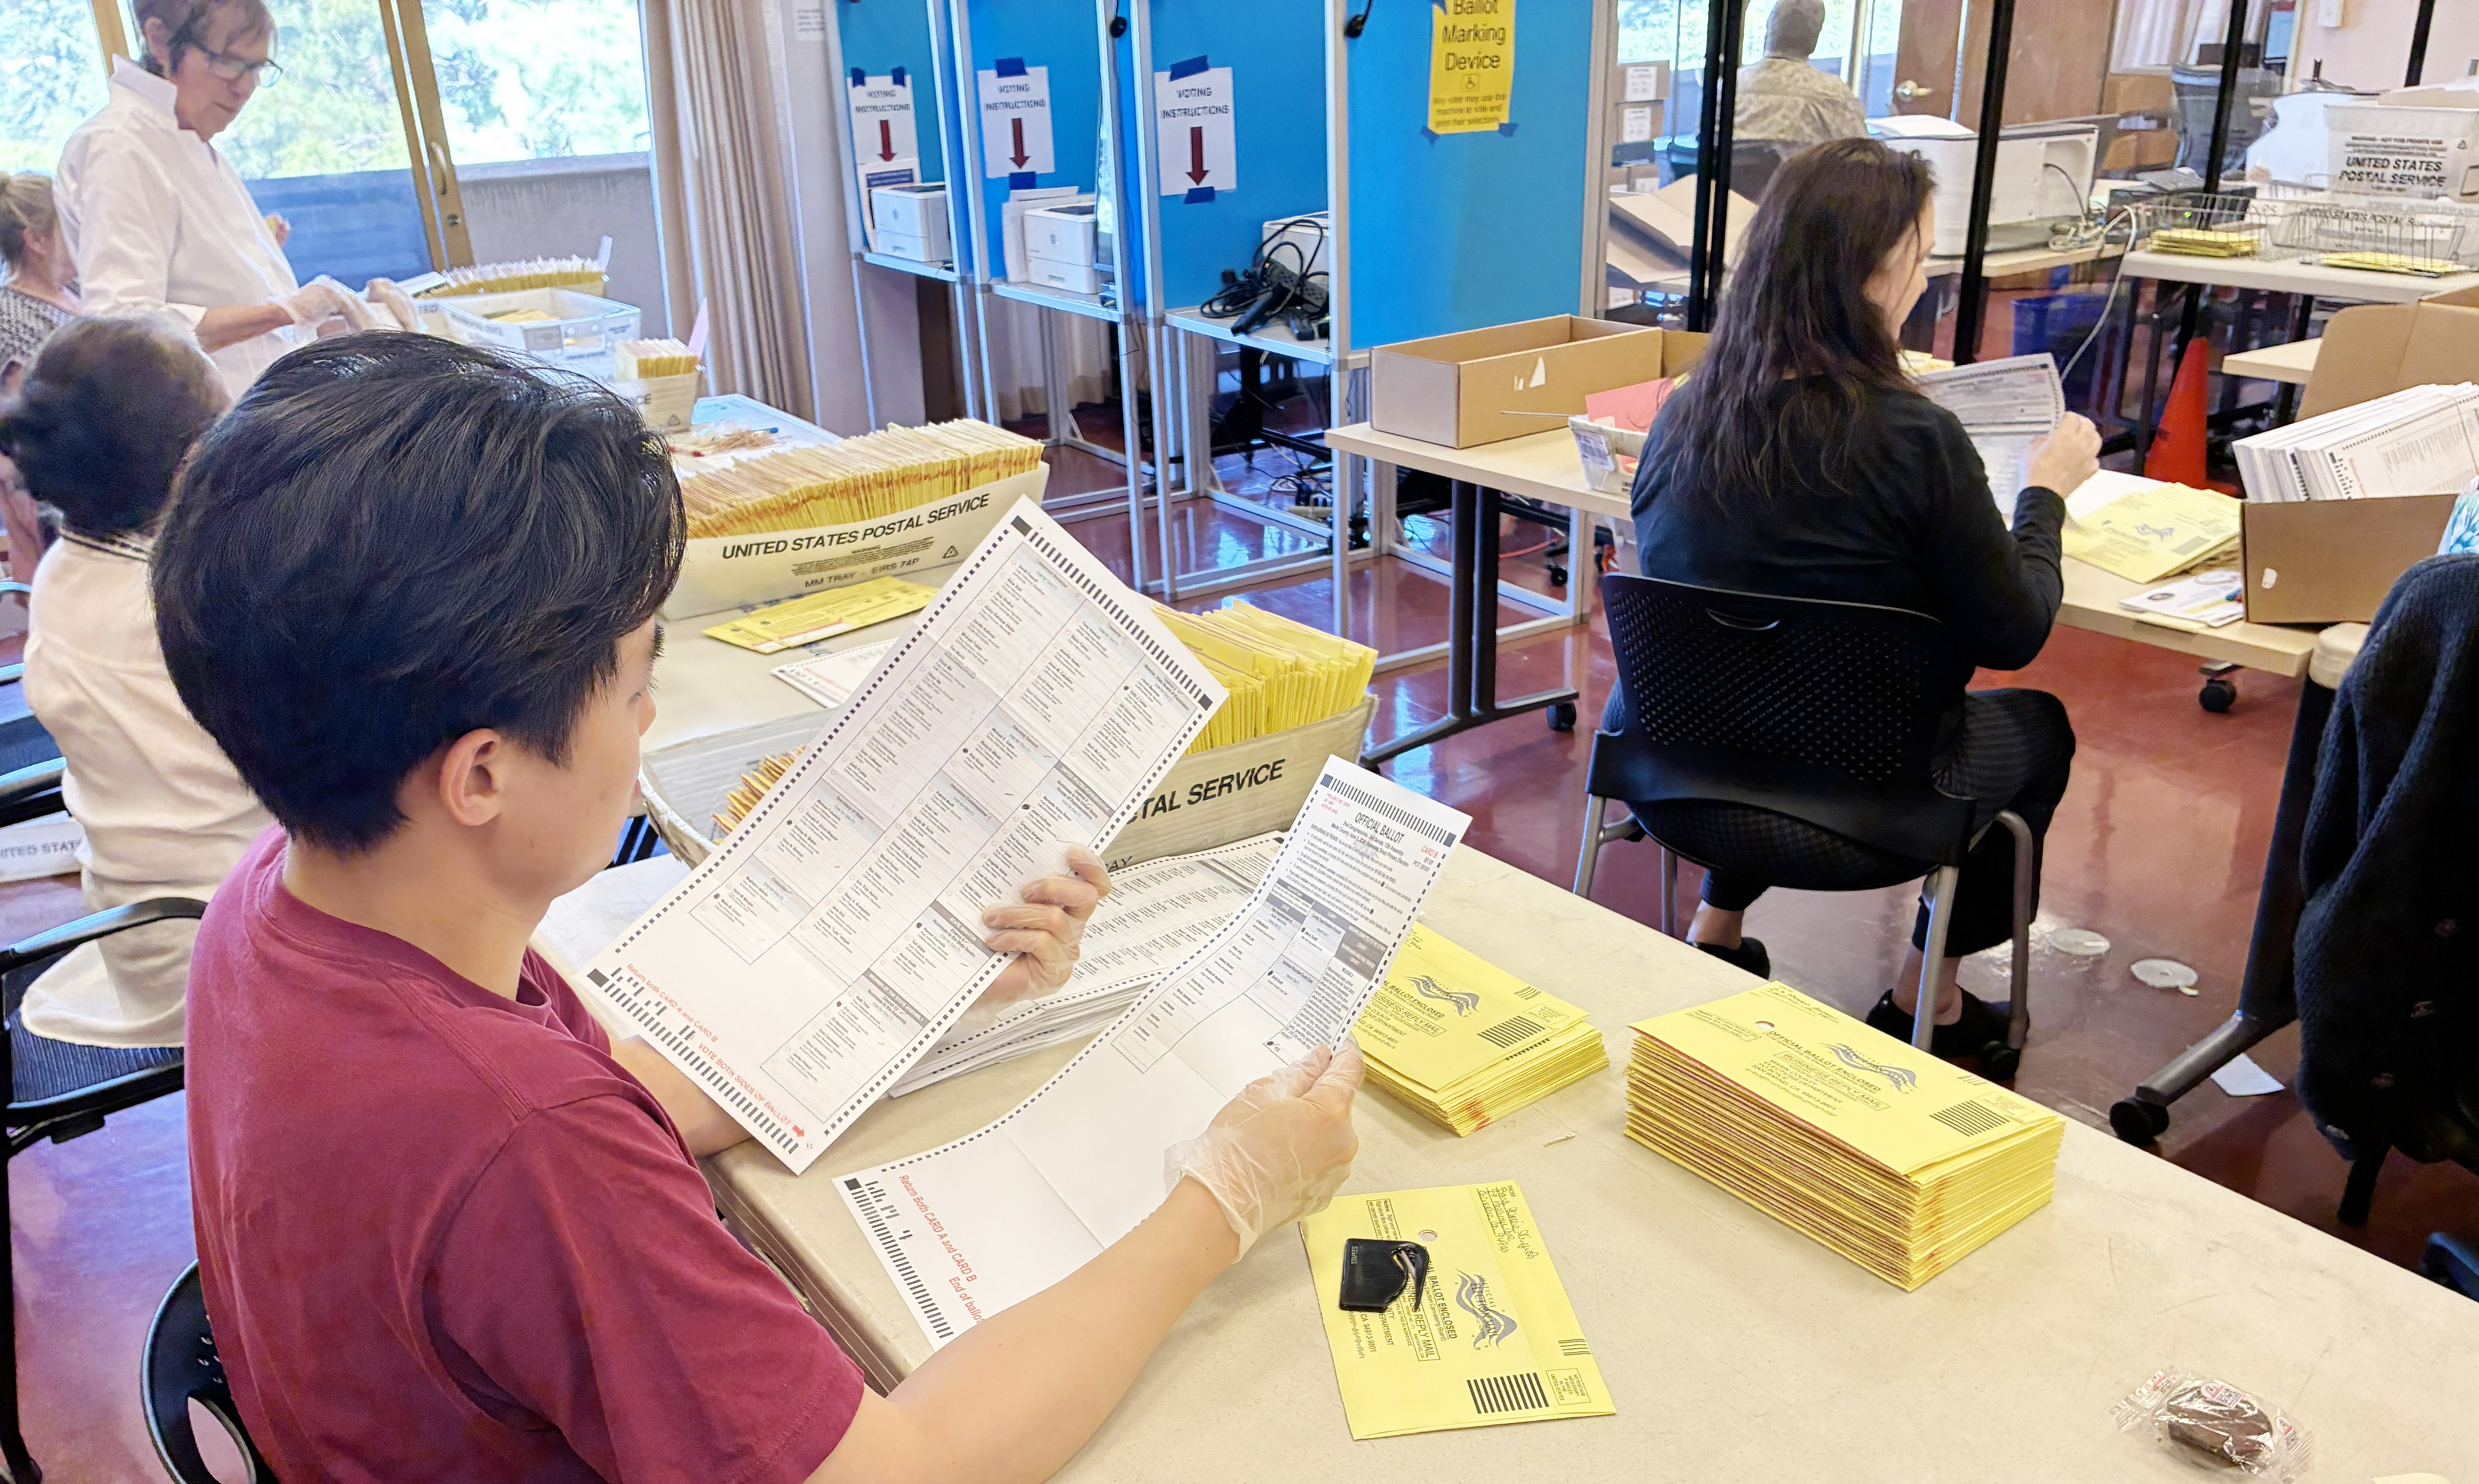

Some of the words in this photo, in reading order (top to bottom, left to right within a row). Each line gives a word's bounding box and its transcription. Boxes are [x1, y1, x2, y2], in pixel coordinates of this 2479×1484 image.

[1442, 23, 1506, 45] Marking
[1445, 51, 1501, 71] Device
[998, 83, 1031, 93] VOTING
[1176, 87, 1212, 98] VOTING
[1161, 104, 1230, 119] INSTRUCTIONS
[2346, 156, 2390, 169] UNITED
[2393, 158, 2443, 172] STATES
[2339, 170, 2386, 183] POSTAL
[2390, 172, 2446, 187] SERVICE
[722, 538, 789, 560] UNITED
[791, 531, 858, 551] STATES
[861, 517, 925, 541] POSTAL
[927, 493, 991, 525] SERVICE
[805, 577, 825, 588] MM
[827, 571, 857, 585] TRAY
[1187, 758, 1286, 806] SERVICE
[1354, 811, 1382, 833] OFFICIAL
[1378, 824, 1405, 845] BALLOT
[1388, 983, 1414, 1001] BALLOT
[1411, 997, 1445, 1020] ENCLOSED
[1401, 1008, 1425, 1026] REPLY
[1422, 1021, 1440, 1034] MAIL
[1767, 1029, 1804, 1053] OFFICIAL
[1802, 1047, 1835, 1070] BALLOT
[1833, 1064, 1882, 1094] ENCLOSED
[698, 1041, 717, 1061] VOTE
[715, 1058, 736, 1077] BOTH
[733, 1074, 756, 1096] SIDES
[753, 1091, 765, 1103] OF
[763, 1100, 793, 1126] BALLOT
[1782, 1051, 1829, 1081] BUSINESS
[1827, 1074, 1859, 1097] REPLY
[1856, 1090, 1884, 1110] MAIL
[899, 1175, 917, 1197] Return
[913, 1196, 929, 1213] Both
[924, 1212, 945, 1233] CARD
[938, 1232, 947, 1240] A
[942, 1239, 957, 1253] and
[951, 1253, 973, 1275] CARD
[1350, 1246, 1358, 1264] STAPLES
[948, 1277, 962, 1293] End
[959, 1292, 971, 1301] of
[967, 1274, 978, 1283] B
[1401, 1276, 1423, 1312] USINES
[1480, 1276, 1496, 1308] OFFICIAL
[1386, 1307, 1395, 1320] NTY
[1429, 1274, 1444, 1301] BALLOT
[1438, 1301, 1457, 1340] ENCLOSED
[1470, 1282, 1490, 1317] ELECTION
[1484, 1319, 1498, 1339] MAIL
[1378, 1312, 1393, 1346] EPARTMENT
[1413, 1312, 1430, 1338] REPLY
[1421, 1338, 1435, 1358] MAIL
[1550, 1373, 1559, 1387] UNITED
[1565, 1381, 1573, 1395] MAILED
[1568, 1375, 1579, 1396] NECESSARY
[1575, 1379, 1585, 1397] POSTAGE
